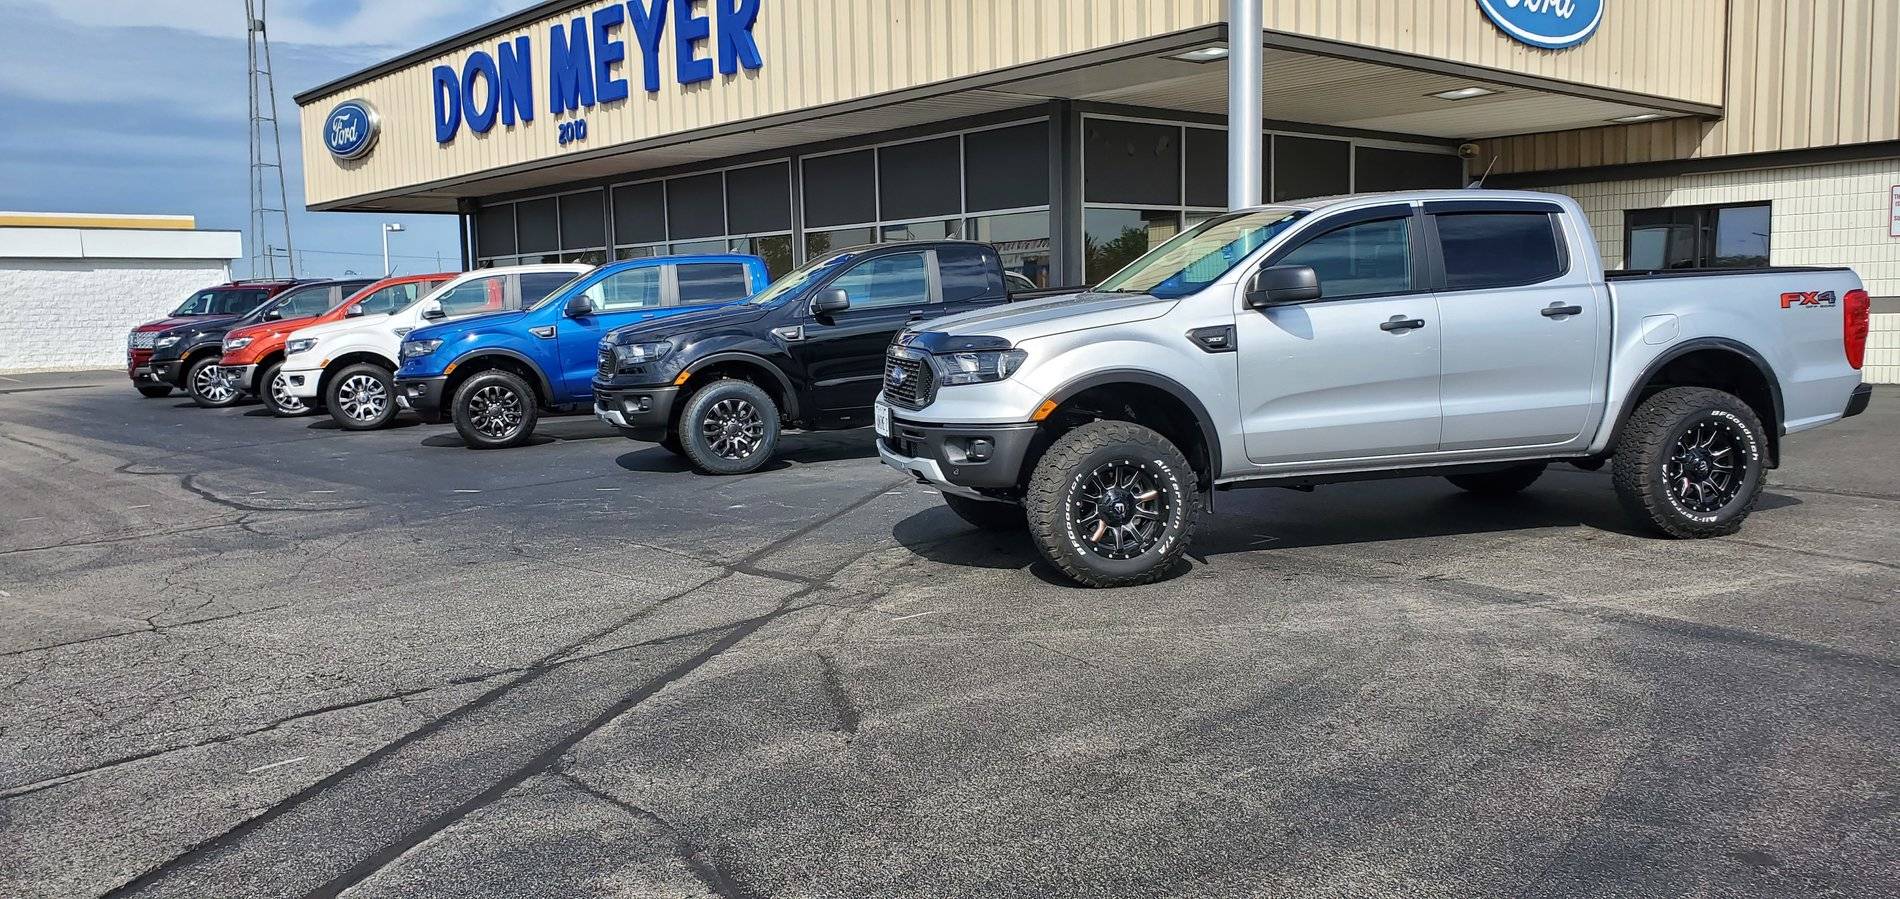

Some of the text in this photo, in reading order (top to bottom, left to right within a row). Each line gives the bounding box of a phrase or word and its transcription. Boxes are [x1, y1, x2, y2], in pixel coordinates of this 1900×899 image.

[432, 0, 763, 144] DON MEYER
[331, 113, 358, 147] Ford
[558, 119, 587, 145] 2010
[1780, 290, 1836, 308] FX4
[1711, 410, 1759, 461] BFGoodrich
[1065, 473, 1086, 556] BFGoodrich
[1153, 459, 1182, 529] All-Terrain
